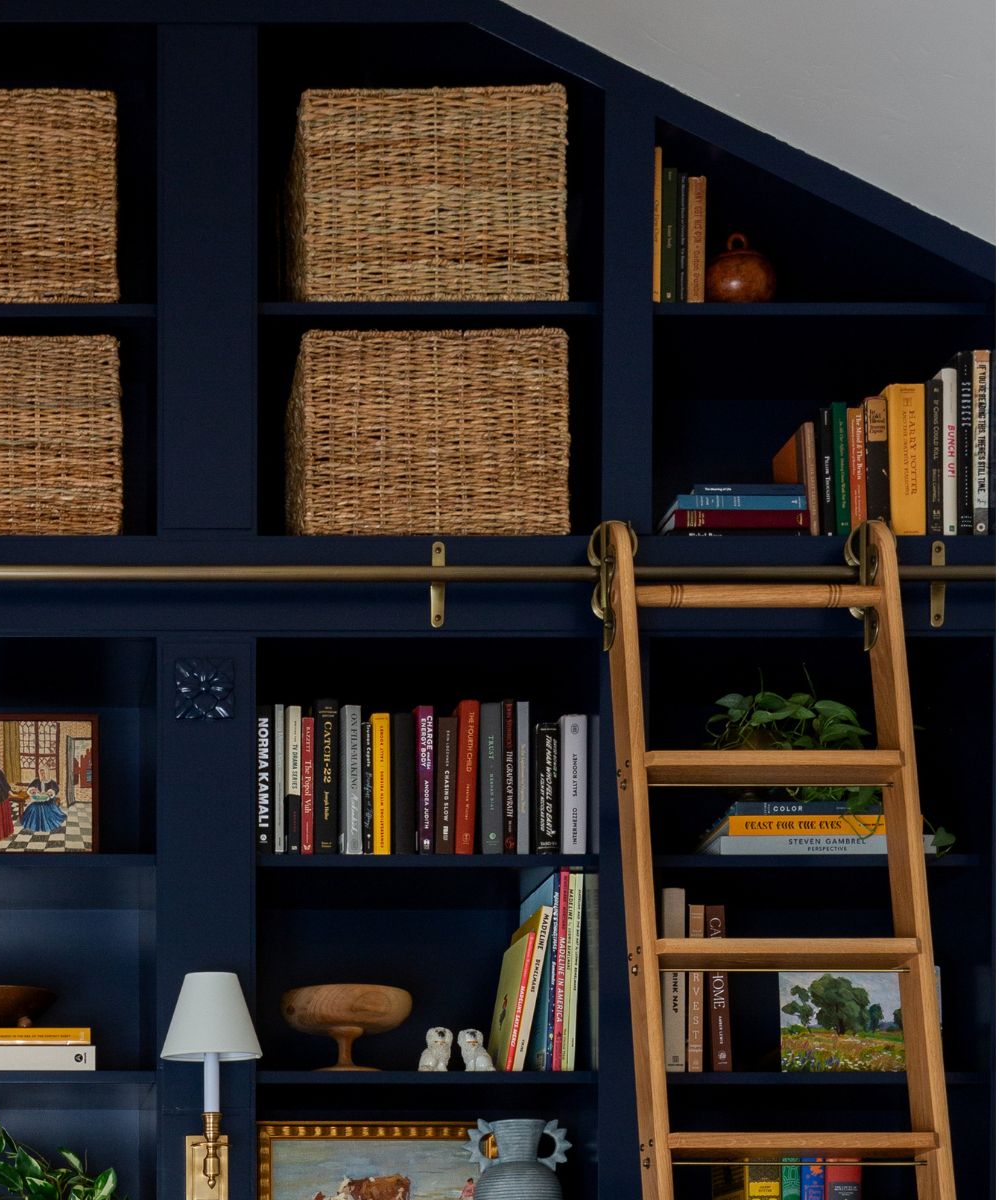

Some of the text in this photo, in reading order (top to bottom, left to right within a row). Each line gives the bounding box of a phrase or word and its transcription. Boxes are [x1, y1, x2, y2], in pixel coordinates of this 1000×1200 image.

[978, 394, 986, 476] READING THERE'S STILL
[350, 713, 358, 726] ON
[324, 721, 332, 784] CATCH-22
[258, 718, 268, 828] NORMA KAMALI
[302, 776, 312, 796] Popol
[545, 812, 554, 838] EARTH
[546, 802, 552, 811] TO
[744, 821, 842, 830] FEAST FOR THE EYES
[530, 913, 550, 993] MADELINE BEMELMANS
[558, 936, 566, 976] MADELINE
[558, 978, 564, 986] IN
[712, 973, 726, 1010] HOME
[514, 986, 526, 1028] MADELINE SAYS
